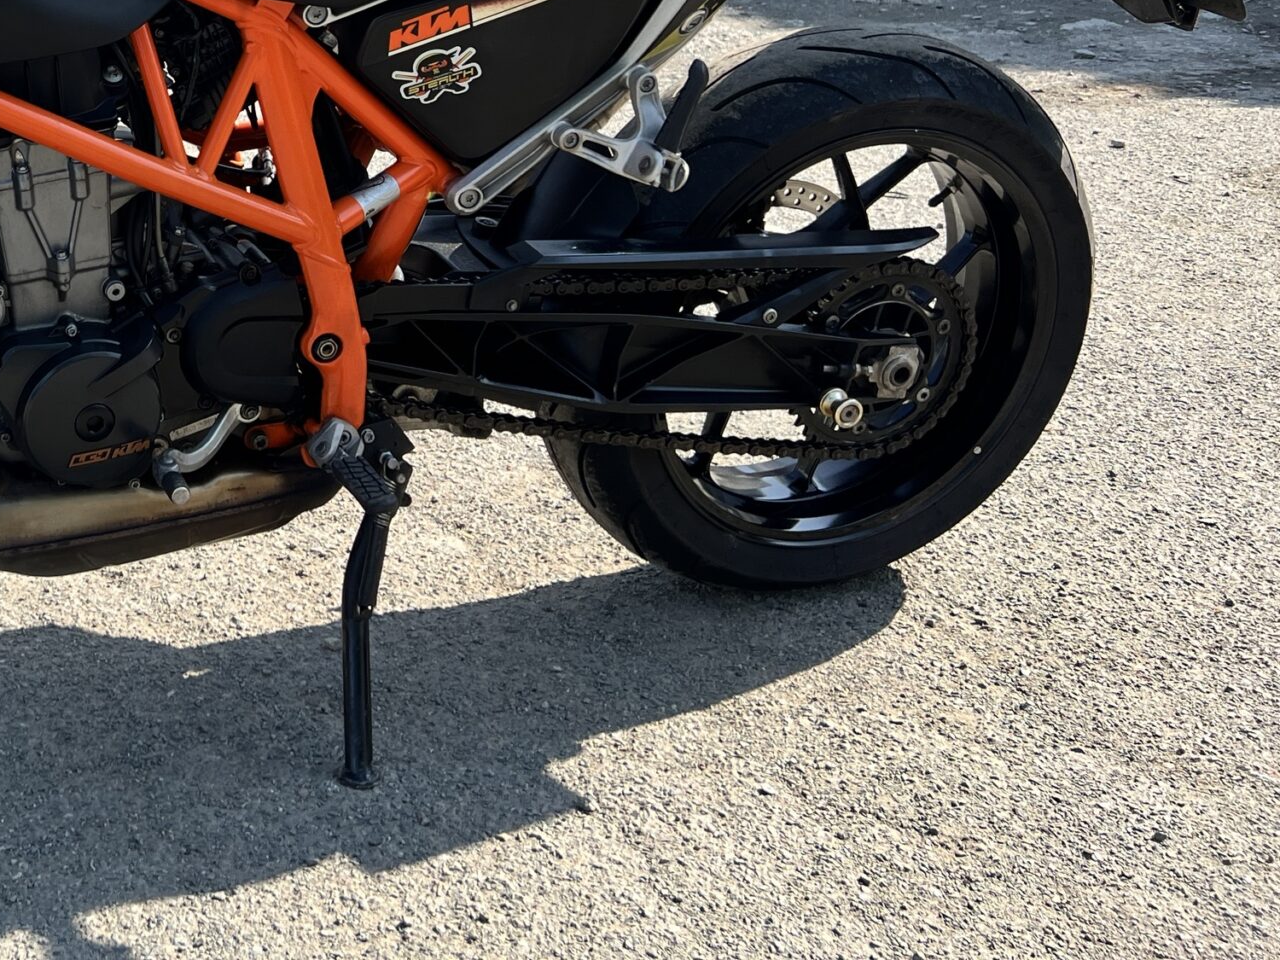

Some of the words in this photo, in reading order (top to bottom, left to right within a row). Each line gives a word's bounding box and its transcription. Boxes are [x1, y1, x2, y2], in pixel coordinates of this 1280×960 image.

[389, 5, 470, 52] KTM
[408, 67, 475, 96] STEALTH
[112, 440, 151, 459] KTM
